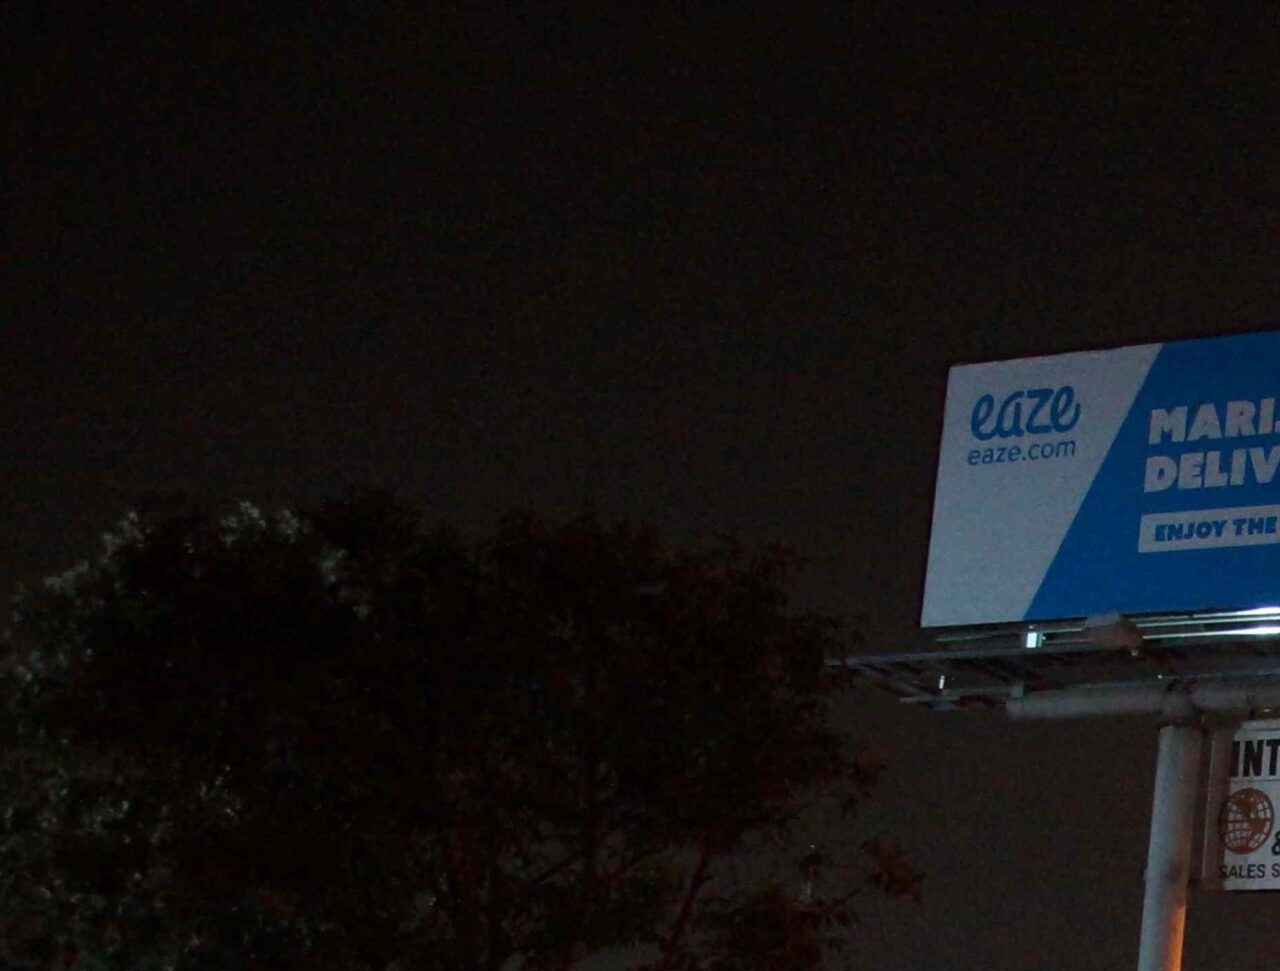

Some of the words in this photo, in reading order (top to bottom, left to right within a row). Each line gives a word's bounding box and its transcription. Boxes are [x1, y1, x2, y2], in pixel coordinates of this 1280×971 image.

[971, 386, 1081, 441] eaze
[968, 440, 1075, 466] eaze.com
[1154, 519, 1228, 542] ENJOY
[1232, 514, 1278, 537] THE
[1219, 864, 1266, 879] SALES
